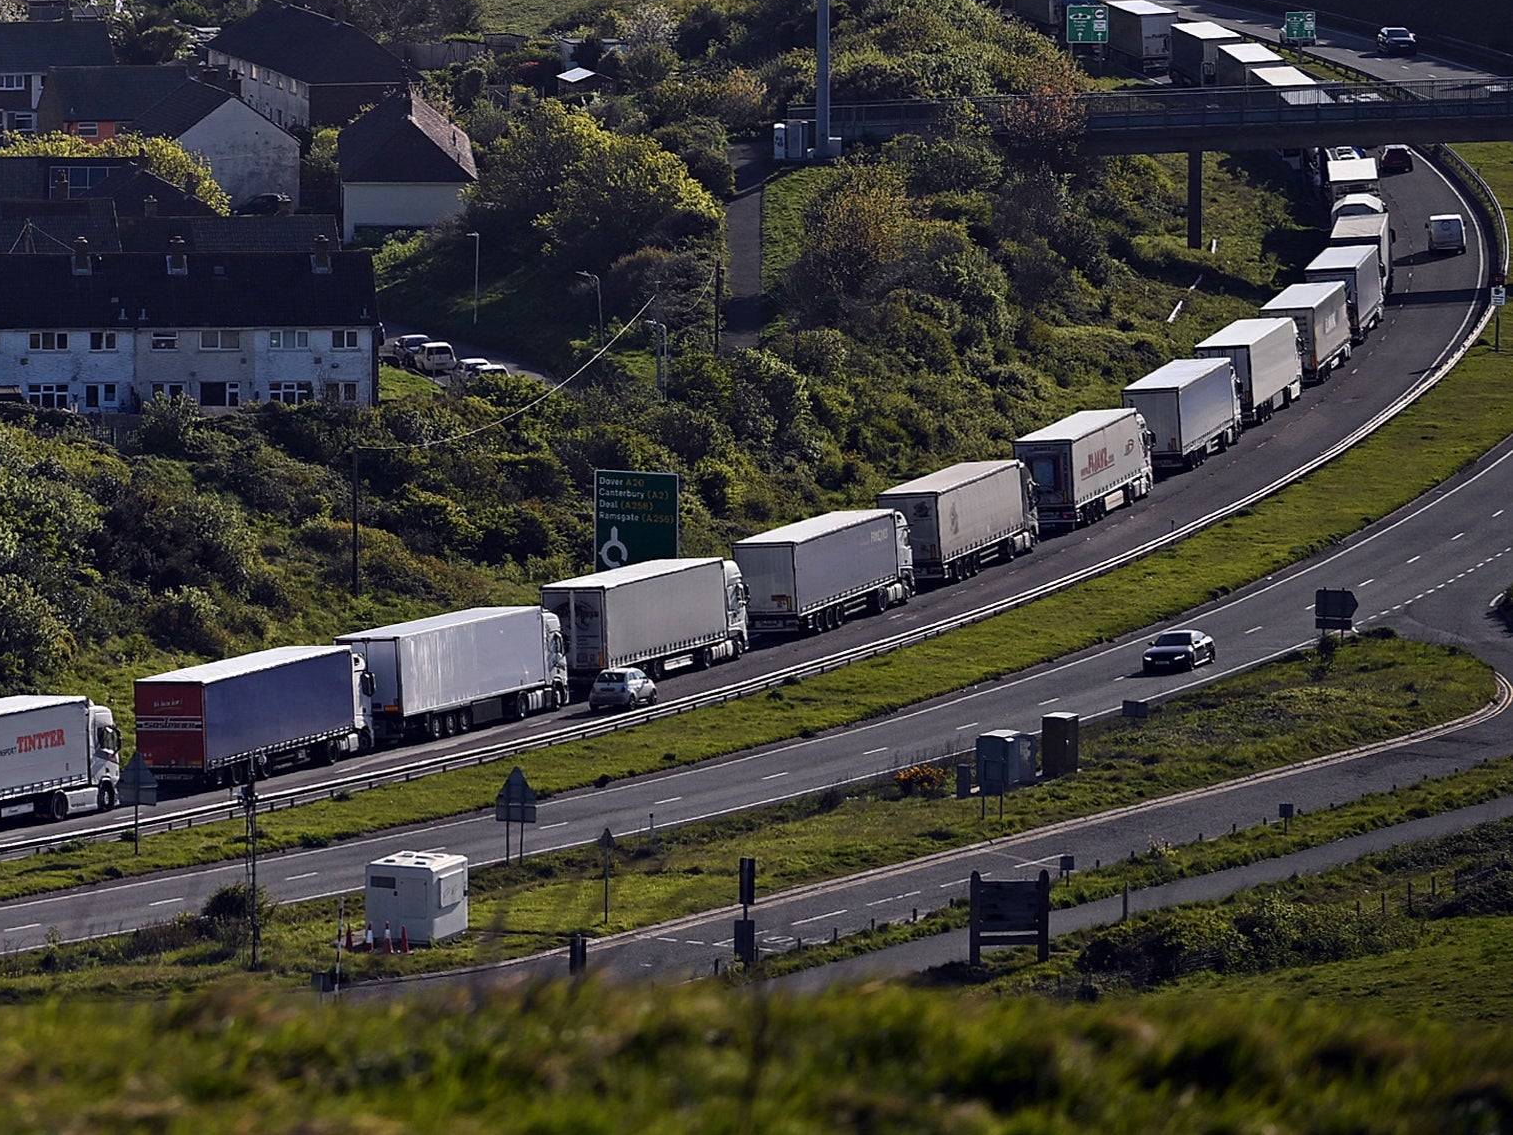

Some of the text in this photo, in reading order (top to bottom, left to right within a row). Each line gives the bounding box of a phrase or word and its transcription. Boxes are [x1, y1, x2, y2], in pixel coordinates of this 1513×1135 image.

[599, 477, 644, 487] Dover A20
[599, 488, 669, 500] Canterbury (A2)
[599, 500, 618, 508] Deal
[599, 512, 639, 522] Ramsgate
[17, 728, 66, 754] TINTTER
